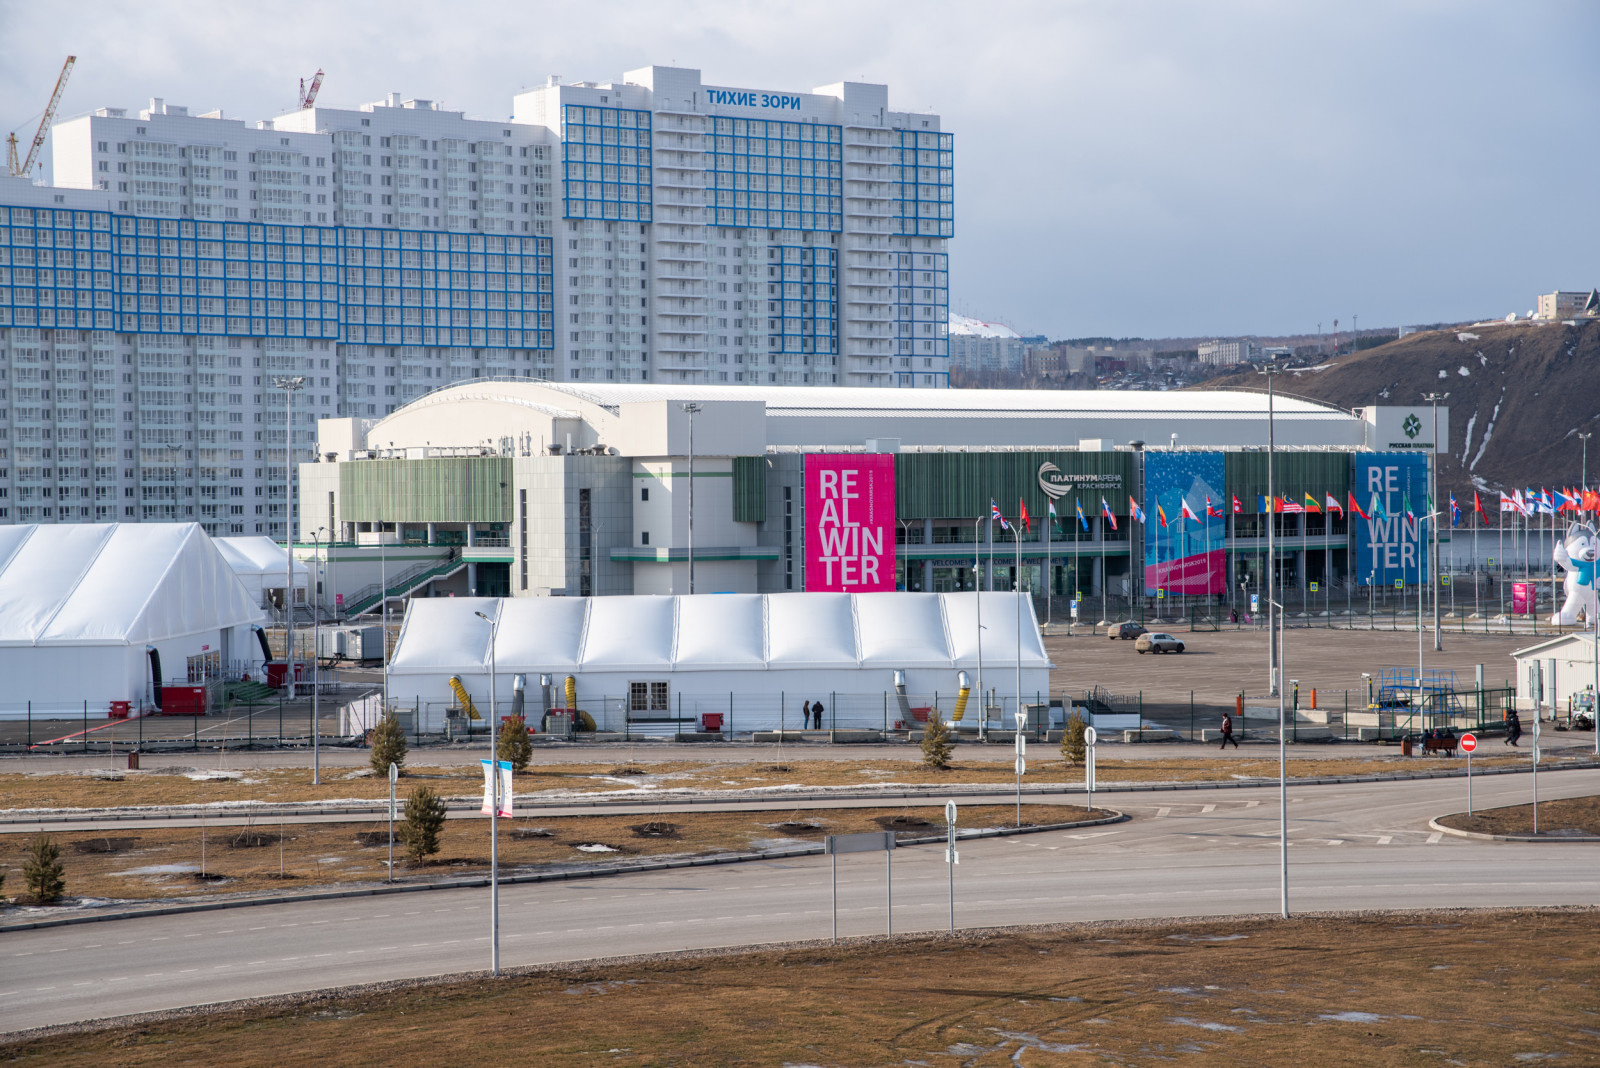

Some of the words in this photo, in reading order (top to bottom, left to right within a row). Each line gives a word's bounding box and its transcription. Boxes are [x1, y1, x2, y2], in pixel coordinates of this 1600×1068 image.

[706, 89, 757, 107] ТИХИЕ
[761, 94, 801, 111] ЗОРИ
[819, 469, 859, 499] RE
[1367, 466, 1400, 492] RE
[818, 498, 860, 528] AL
[818, 526, 883, 557] WIN
[1367, 516, 1419, 543] WIN
[1366, 542, 1416, 569] TER
[818, 555, 880, 586] TER
